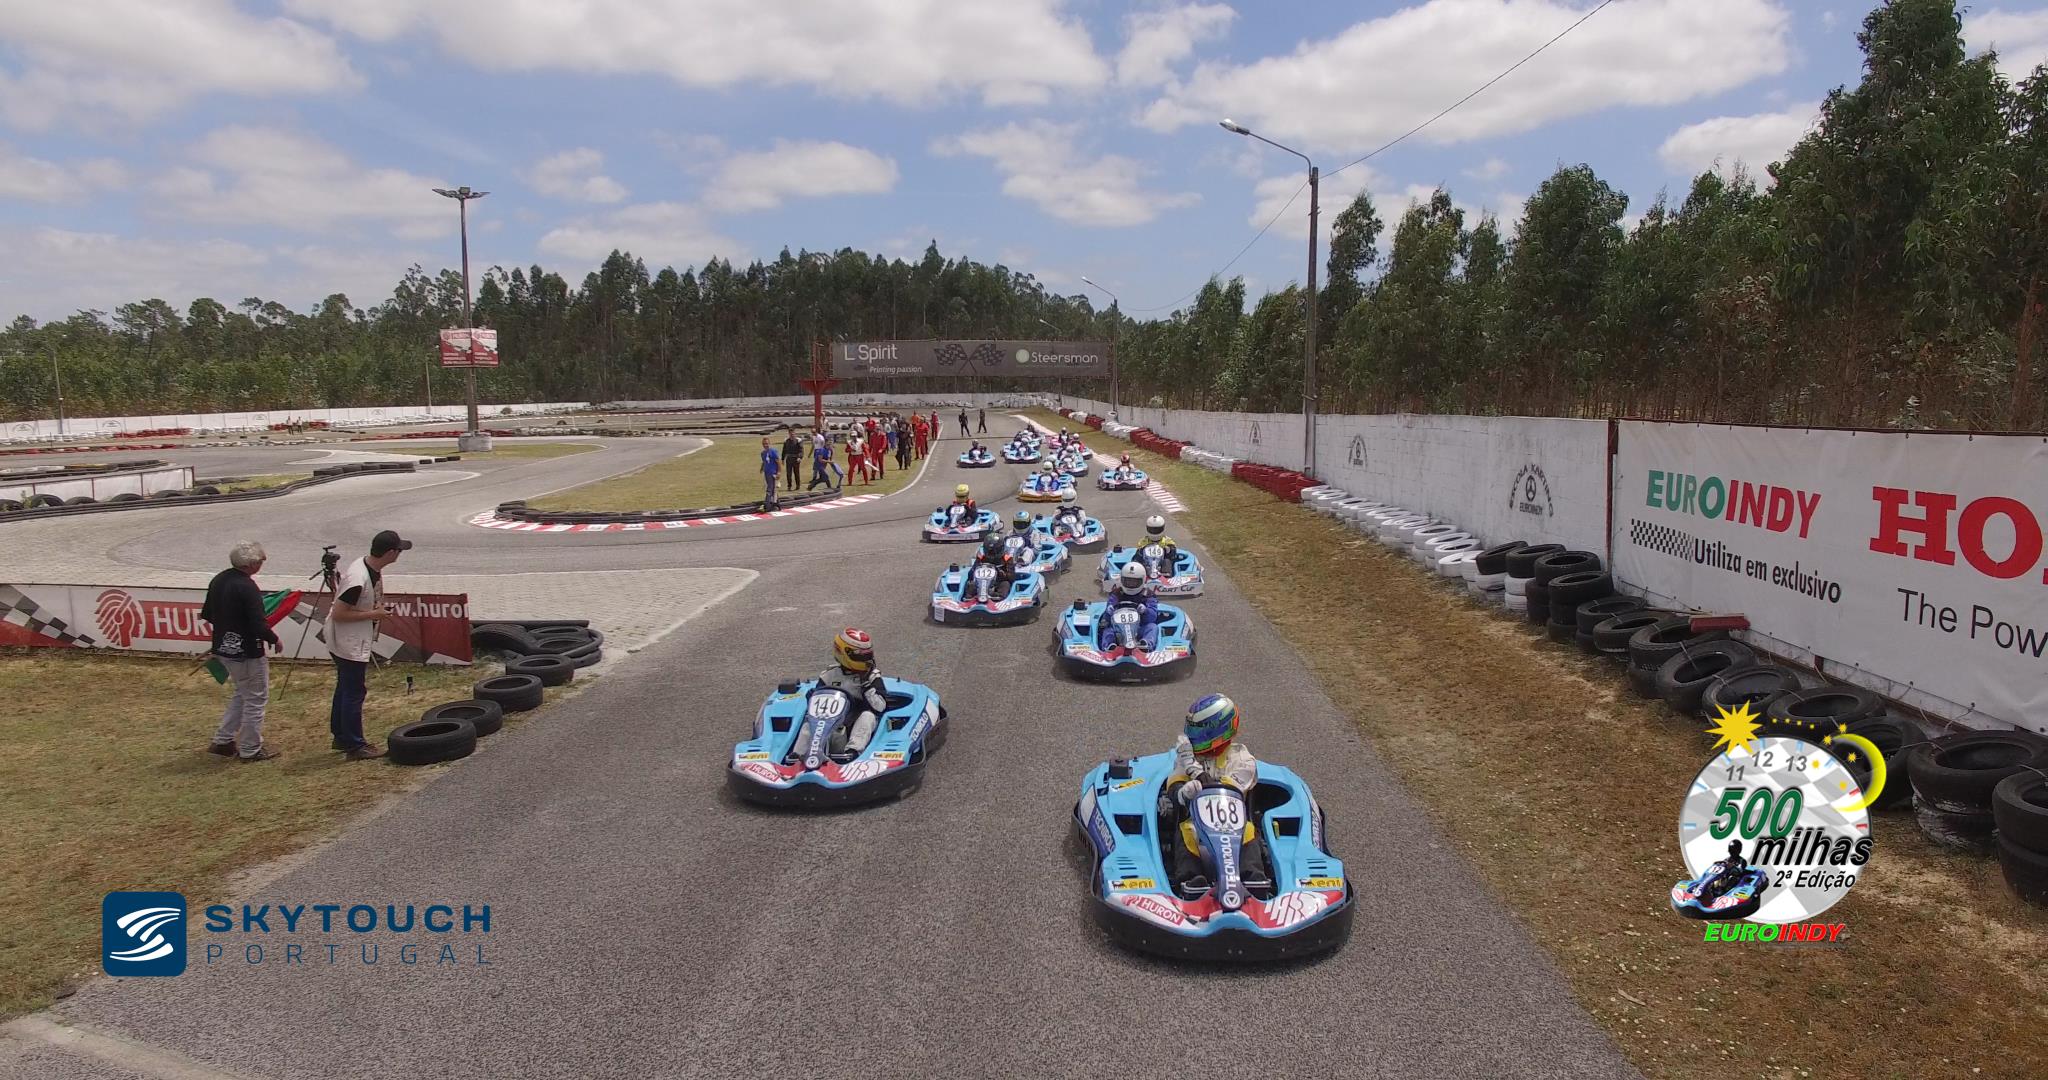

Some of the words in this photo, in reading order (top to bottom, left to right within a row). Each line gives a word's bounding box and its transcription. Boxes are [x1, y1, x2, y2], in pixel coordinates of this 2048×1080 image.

[844, 344, 856, 360] L
[858, 343, 898, 364] Spirit
[1031, 351, 1098, 364] Steersman
[869, 366, 896, 374] Printing
[896, 366, 922, 374] passion
[1509, 464, 1528, 509] ESCOLA
[1531, 463, 1554, 517] KARTING
[1646, 469, 1822, 539] EUROINDY
[1869, 486, 2048, 585] HO
[1694, 538, 1742, 574] Utiliza
[1746, 559, 1767, 581] em
[1772, 561, 1842, 604] exclusivo
[152, 606, 214, 637] HUR
[1120, 613, 1134, 623] 88
[1897, 587, 1957, 633] The
[814, 698, 839, 715] 140
[1205, 800, 1239, 825] 168
[1129, 879, 1153, 889] eni
[1141, 898, 1181, 923] HURON
